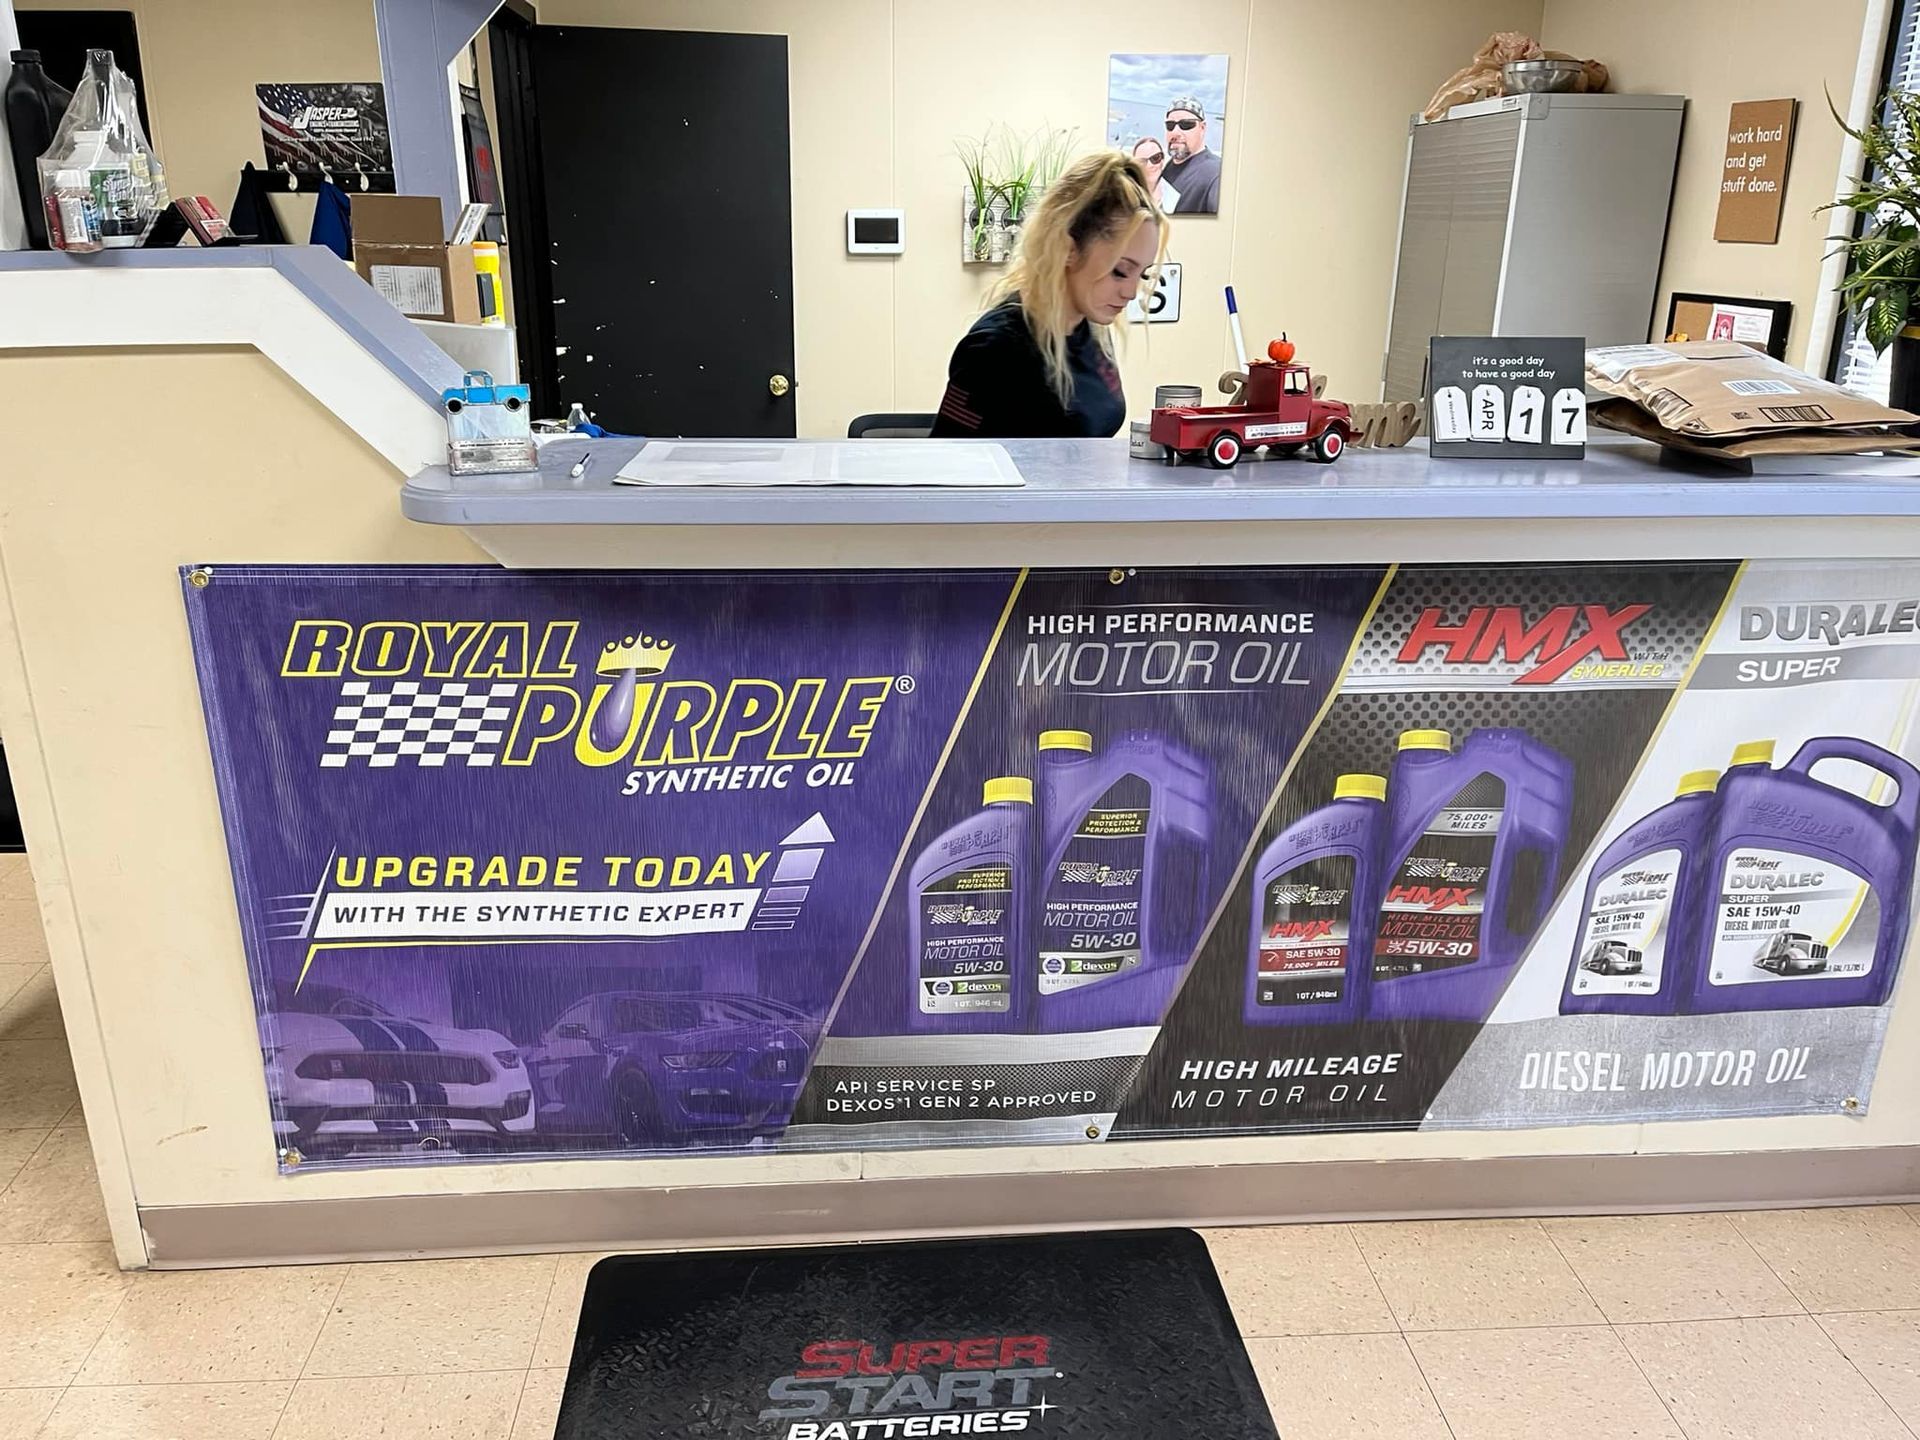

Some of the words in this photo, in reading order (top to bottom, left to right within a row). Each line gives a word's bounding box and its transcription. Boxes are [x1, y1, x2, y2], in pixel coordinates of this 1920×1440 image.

[292, 106, 342, 129] JASPER
[1729, 127, 1754, 143] work
[1756, 124, 1783, 143] hard
[1726, 152, 1746, 168] and
[1748, 153, 1767, 171] get
[1722, 176, 1746, 193] stuff
[1748, 176, 1777, 193] done.
[1472, 356, 1488, 366] it's
[1490, 358, 1497, 366] a
[1499, 357, 1524, 368] good
[1526, 356, 1545, 367] day
[1462, 370, 1473, 378] to
[1475, 369, 1499, 378] have
[1509, 370, 1534, 380] good
[1537, 369, 1556, 380] day
[1482, 398, 1495, 431] APR
[1519, 407, 1534, 435] 1
[1561, 407, 1580, 435] 7
[1028, 615, 1095, 635] HIGH
[1105, 612, 1315, 634] PERFORMANCE
[280, 620, 579, 678] ROYAL
[1395, 603, 1656, 685] HMX
[1016, 640, 1220, 687] MOTOR
[1229, 641, 1312, 686] OIL
[1633, 652, 1670, 662] WITH
[1571, 663, 1667, 680] SYNERLEC
[1736, 656, 1842, 682] SUPER
[621, 763, 794, 796] SYNTHETIC
[806, 761, 855, 788] OIL
[336, 856, 583, 888] UPGRADE
[604, 851, 772, 886] TODAY
[1730, 871, 1825, 891] DURALEC
[1071, 901, 1138, 911] PERFORMANCE
[1386, 885, 1476, 911] HMX
[1599, 888, 1667, 907] DURALEC
[1728, 894, 1770, 903] SUPER
[334, 906, 404, 924] WITH
[415, 905, 467, 922] THE
[477, 904, 629, 922] SYNTHETIC
[638, 902, 745, 923] EXPERT
[1043, 912, 1110, 928] MOTOR
[1112, 911, 1138, 926] OIL
[1424, 915, 1478, 923] MILEAGE
[1595, 914, 1610, 926] SAE
[1613, 911, 1645, 923] 15W-40
[1726, 906, 1750, 917] SAE
[1755, 904, 1801, 917] 15W-40
[1268, 919, 1337, 942] HMX
[1381, 922, 1447, 937] MOTOR
[1449, 923, 1476, 938] OIL
[1724, 920, 1749, 931] DIESEL
[1752, 919, 1778, 930] MOTOR
[1779, 918, 1791, 929] OIL
[947, 936, 1005, 945] PERFORMANCE
[1070, 932, 1137, 949] 5W-30
[1404, 940, 1473, 956] 5W-30
[924, 945, 980, 960] MOTOR
[982, 943, 1004, 957] OIL
[1285, 950, 1306, 959] SAE
[1307, 948, 1341, 958] 5W-30
[954, 960, 1004, 974] 5W-30
[1180, 1060, 1259, 1080] HIGH
[1266, 1053, 1402, 1079] MILEAGE
[1519, 1051, 1626, 1092] DIESEL
[1640, 1049, 1756, 1091] MOTOR
[1765, 1047, 1811, 1084] OIL
[835, 1081, 868, 1093] API
[876, 1080, 963, 1092] SERVICE
[971, 1080, 995, 1091] SP
[1171, 1086, 1305, 1109] MOTOR
[1329, 1083, 1387, 1102] OIL
[919, 1096, 960, 1108] GEN
[969, 1096, 979, 1107] 2
[988, 1090, 1096, 1108] APPROVED
[795, 1335, 1051, 1380] SUPER
[758, 1367, 1056, 1421] START
[787, 1410, 1031, 1440] BATTERIES
